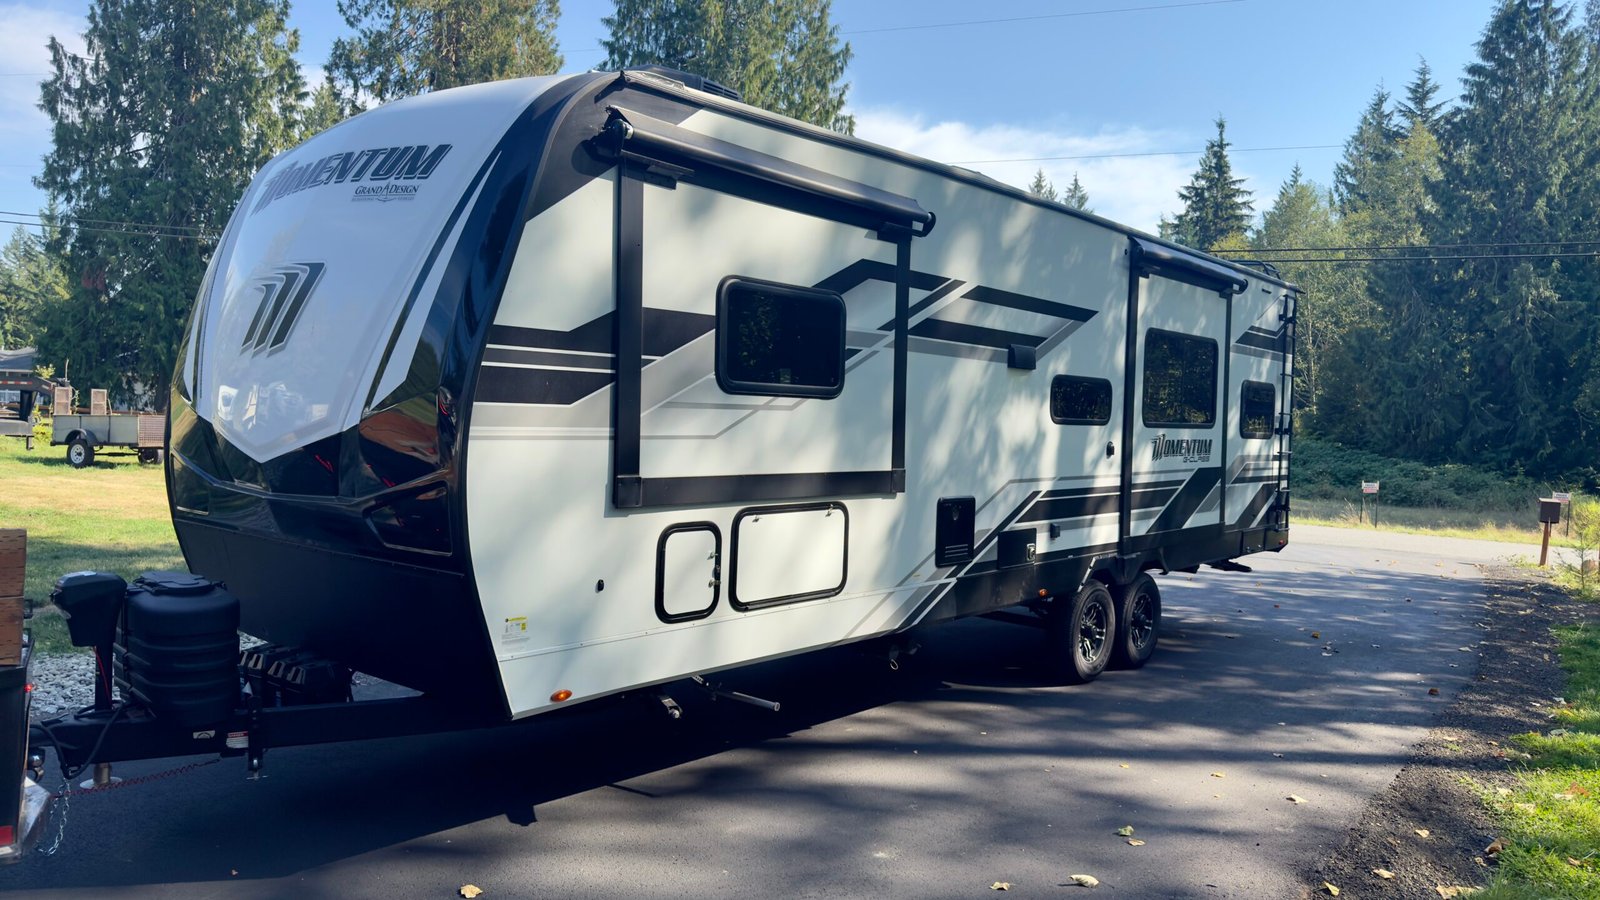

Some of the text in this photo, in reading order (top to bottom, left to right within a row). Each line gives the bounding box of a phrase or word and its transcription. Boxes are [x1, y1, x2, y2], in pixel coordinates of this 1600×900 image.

[251, 144, 453, 216] MOMENTUM
[355, 184, 420, 195] GRAND DESIGN
[1151, 433, 1213, 461] MOMENTUM
